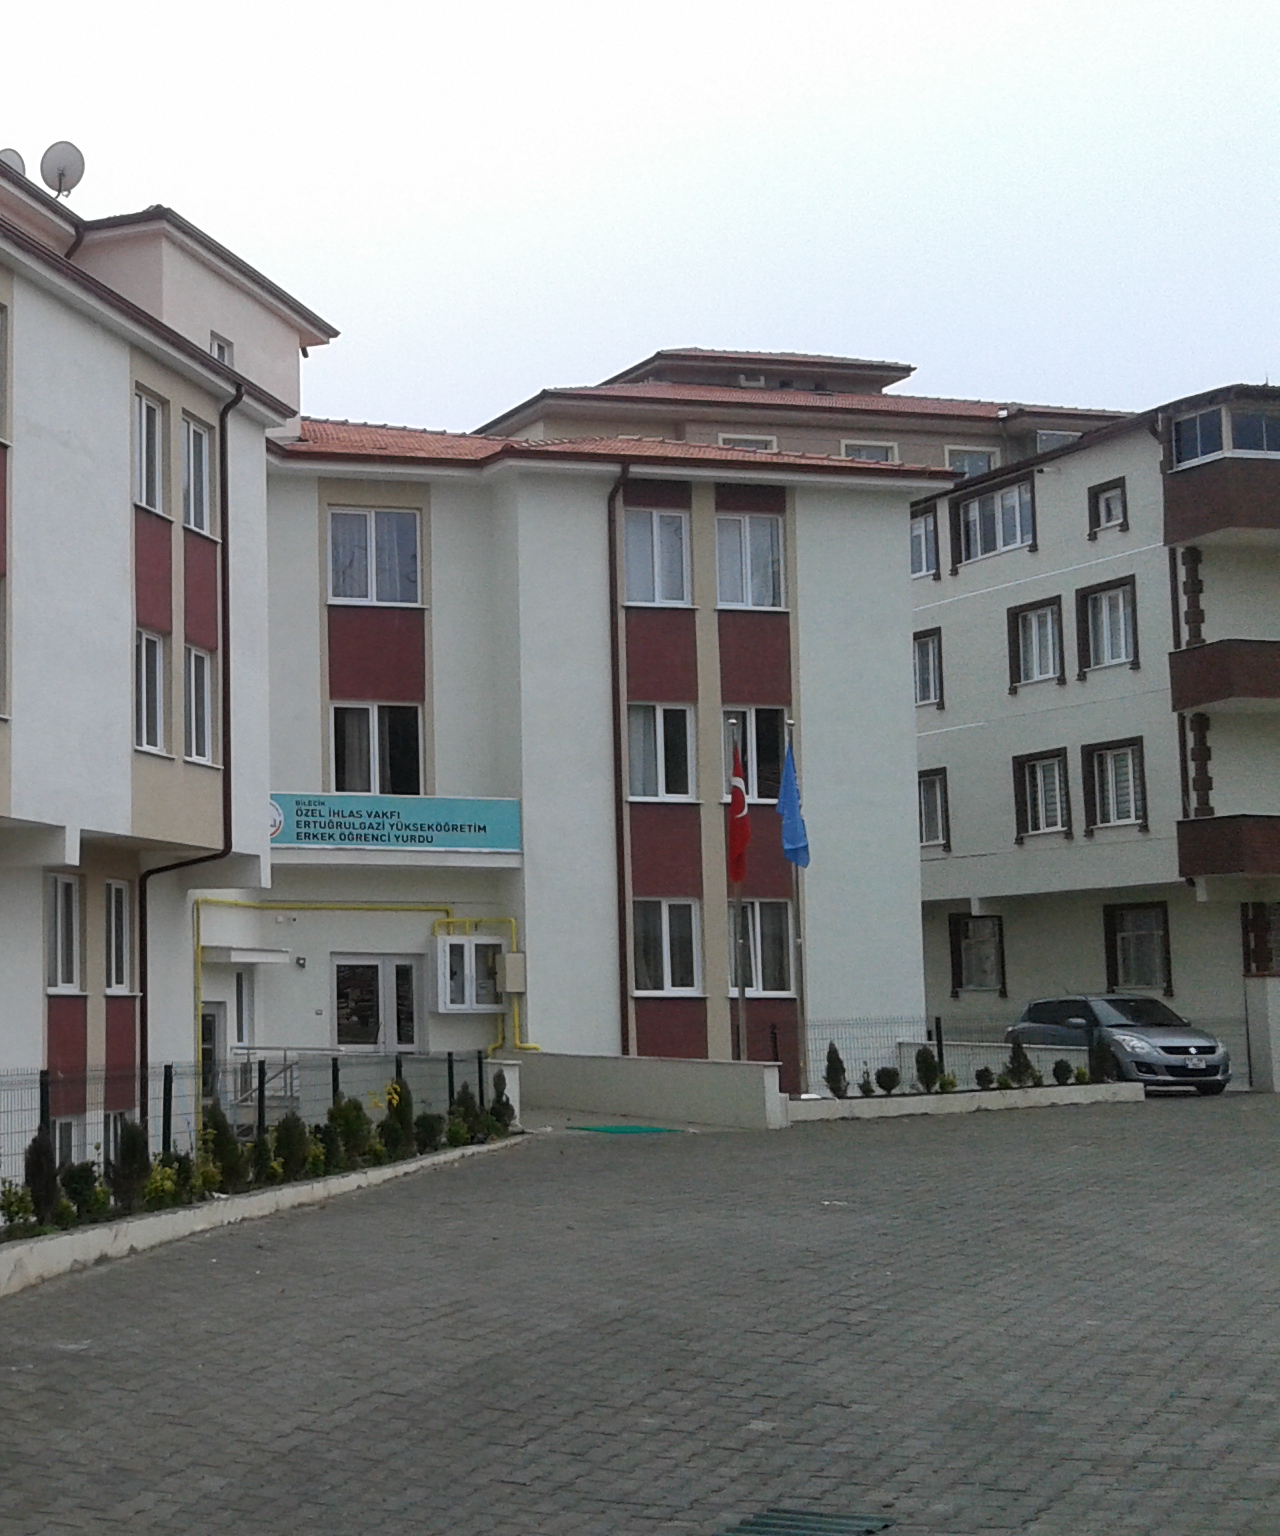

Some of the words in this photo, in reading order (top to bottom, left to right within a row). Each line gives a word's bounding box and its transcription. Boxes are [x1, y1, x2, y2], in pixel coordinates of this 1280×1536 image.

[295, 807, 326, 818] ÖZEL
[328, 807, 363, 819] İHLAS
[365, 810, 401, 820] VAKFI
[295, 819, 386, 831] ERTUĞRULGAZİ
[388, 821, 488, 834] YÜKSEKÖĞRETİM
[296, 832, 336, 842] ERKEK
[338, 831, 391, 843] ÖĞRENCİ
[394, 833, 434, 844] YURDU
